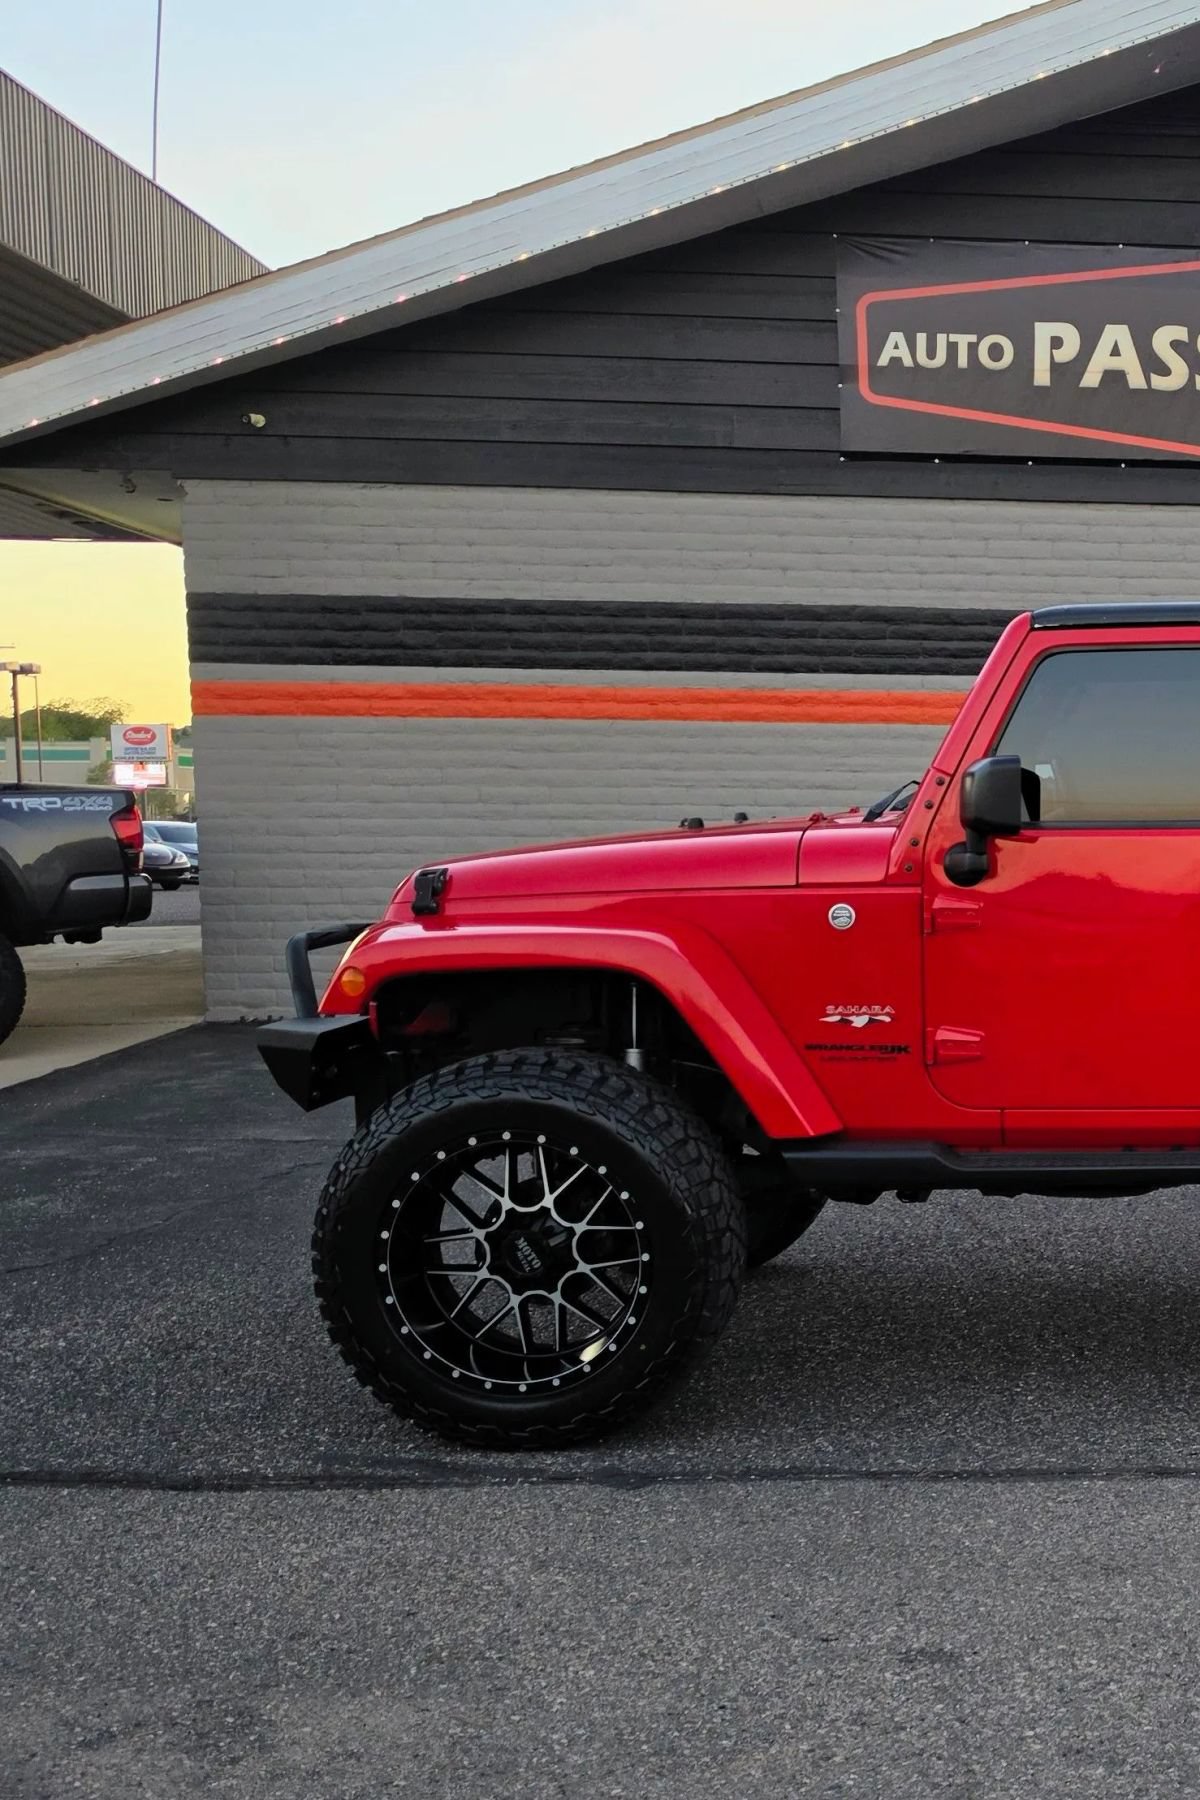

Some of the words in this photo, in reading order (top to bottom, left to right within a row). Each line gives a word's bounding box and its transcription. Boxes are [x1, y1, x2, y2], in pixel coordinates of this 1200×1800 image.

[876, 331, 1015, 370] AUTO
[2, 797, 61, 812] TRD
[825, 1005, 896, 1014] SAHARA
[514, 1236, 542, 1269] MOTO
